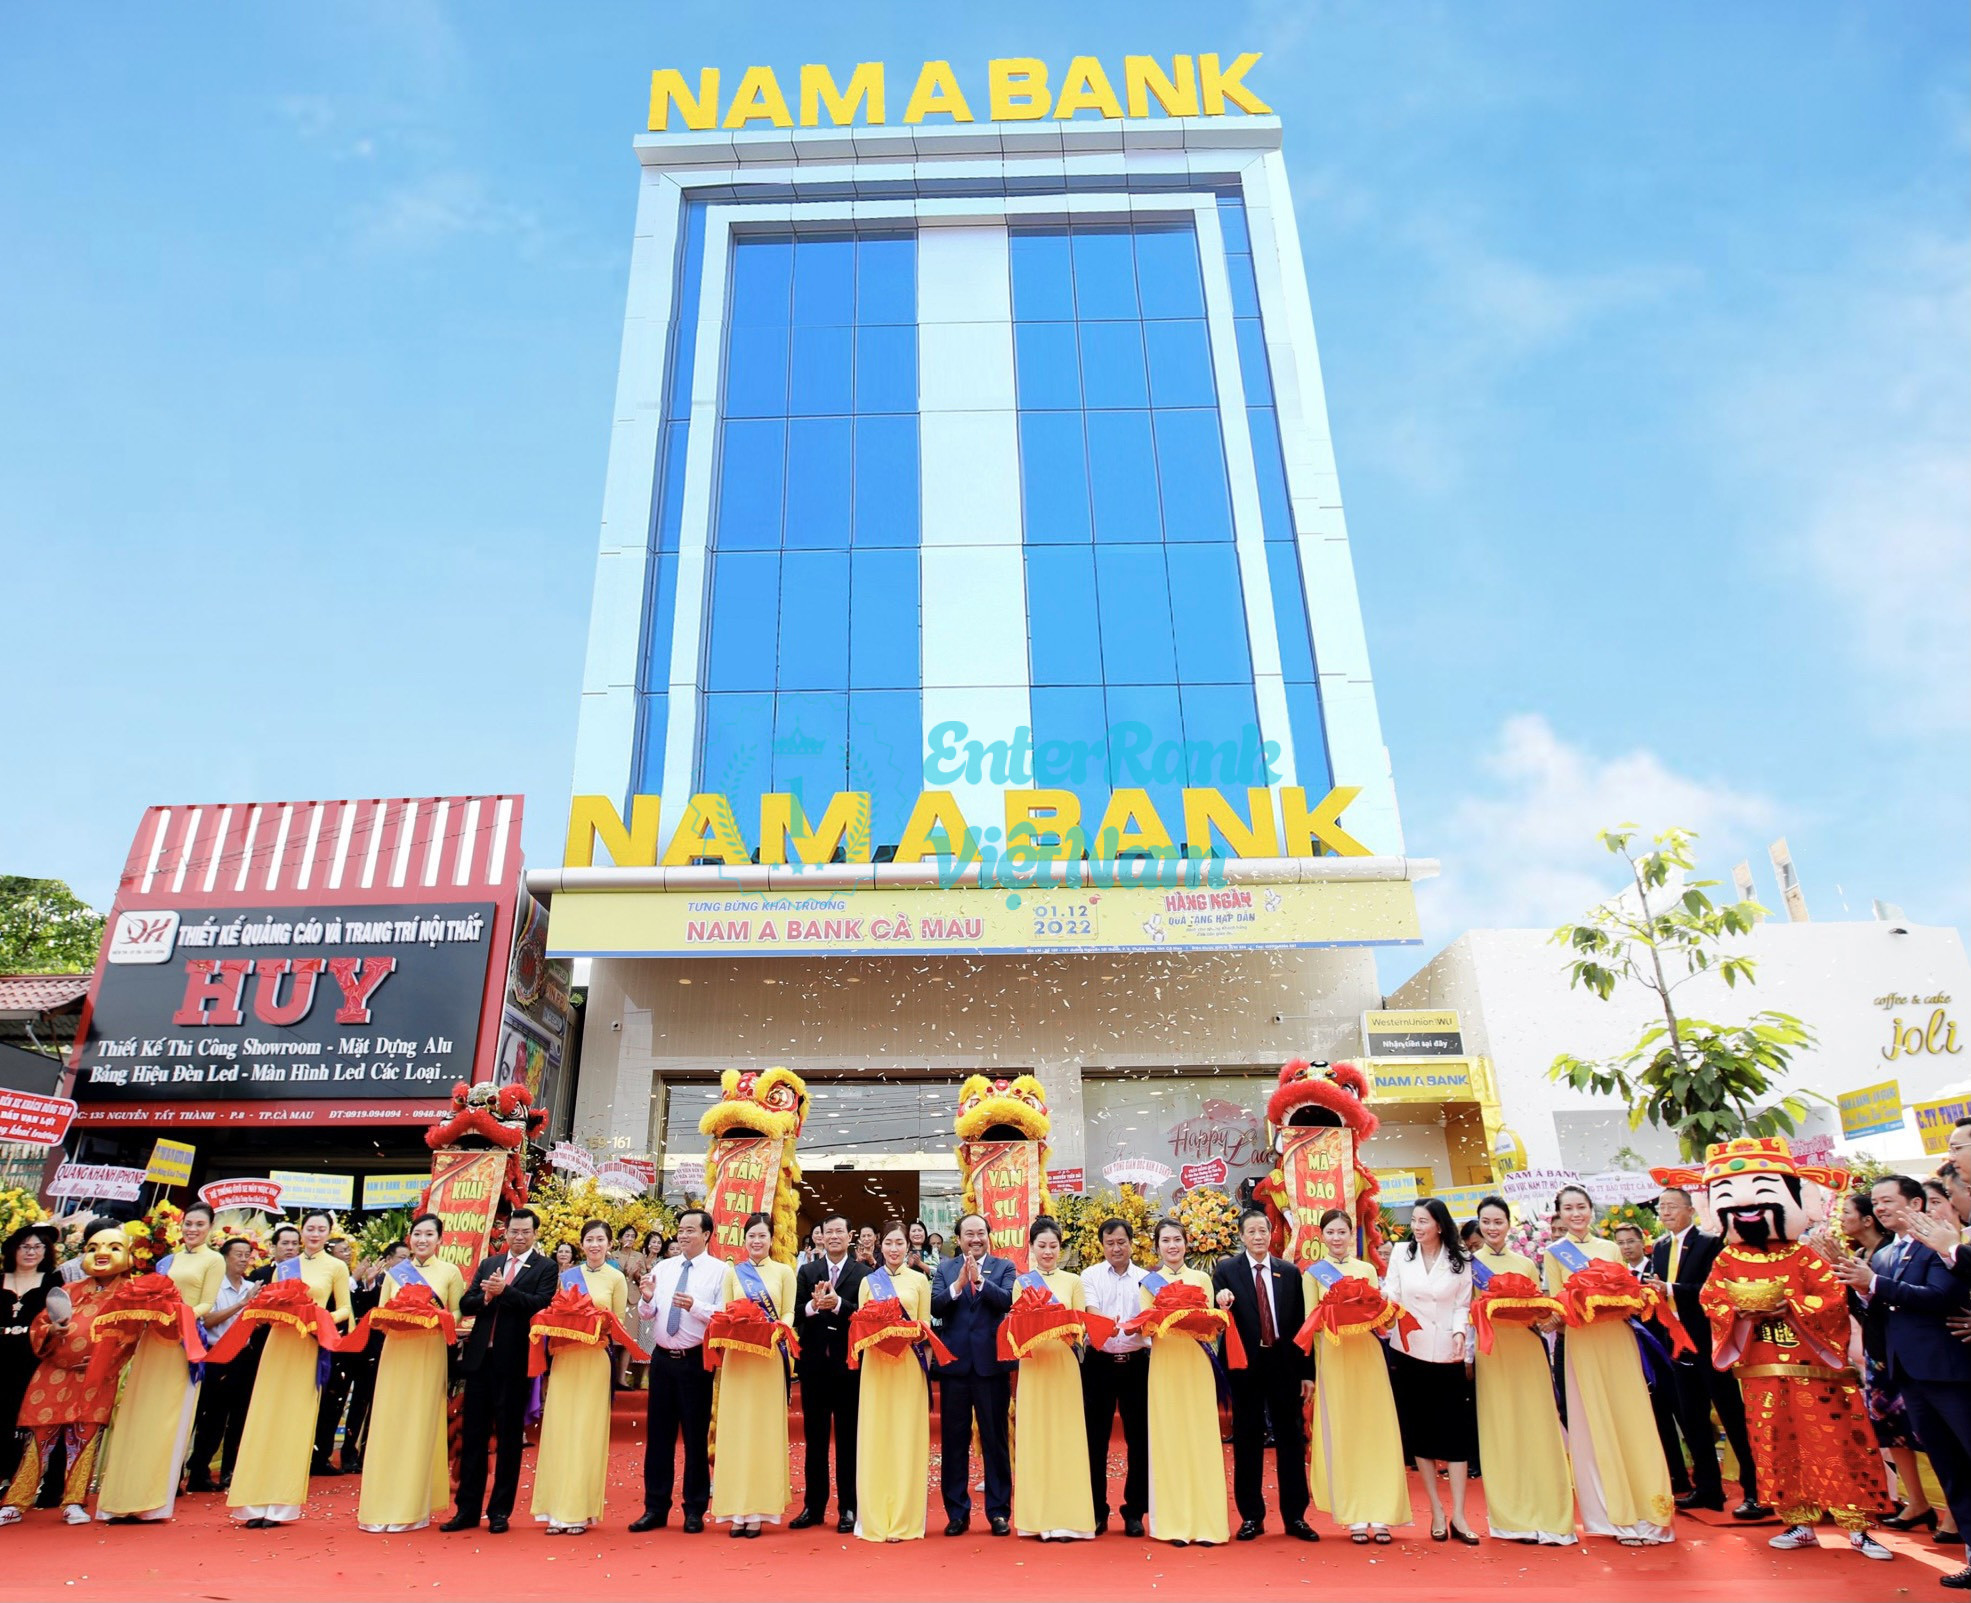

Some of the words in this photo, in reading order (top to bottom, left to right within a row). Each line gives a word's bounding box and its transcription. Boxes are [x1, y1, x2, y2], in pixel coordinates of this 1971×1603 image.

[647, 61, 885, 131] NAM
[903, 60, 975, 123] A
[987, 52, 1273, 121] BANK
[563, 792, 872, 868] NAM
[892, 790, 984, 864] A
[1004, 786, 1376, 862] BANK
[762, 901, 791, 912] KHAI
[1034, 905, 1089, 918] 01.12
[1165, 891, 1208, 912] HÀNG
[178, 915, 221, 947] THIẾT
[218, 914, 248, 946] KẾ
[241, 914, 293, 946] QUẢNG
[293, 916, 323, 945] CÁO
[325, 916, 342, 944] VÀ
[345, 920, 394, 944] TRANG
[394, 915, 422, 943] TRÍ
[419, 914, 446, 949] NỘI
[447, 912, 485, 942] THẤT
[686, 920, 750, 942] NAM
[758, 919, 779, 941] A
[787, 918, 863, 941] BANK
[870, 912, 913, 940] CÀ
[921, 917, 983, 940] MAU
[1033, 919, 1092, 935] 2022
[172, 956, 398, 1027] HUY
[1873, 991, 1909, 1011] coffee
[1911, 994, 1921, 1005] &
[1923, 990, 1953, 1005] cake
[1372, 1017, 1434, 1027] WesternUnion
[1437, 1017, 1453, 1026] WU
[1382, 1040, 1405, 1049] Nhận
[1881, 1008, 1964, 1061] joli
[98, 1036, 137, 1057] Thiết
[140, 1037, 168, 1057] Kế
[167, 1039, 194, 1057] Thi
[197, 1037, 238, 1060] Công
[242, 1037, 321, 1056] Showroom
[338, 1037, 371, 1059] Mặt
[374, 1037, 418, 1059] Dựng
[423, 1036, 453, 1054] Alu
[88, 1064, 128, 1087] Bảng
[131, 1065, 170, 1086] Hiệu
[172, 1064, 204, 1082] Đèn
[206, 1064, 240, 1082] Led
[250, 1064, 287, 1082] Màn
[289, 1063, 329, 1081] Hình
[333, 1062, 366, 1081] Led
[370, 1061, 400, 1080] Các
[1375, 1075, 1411, 1087] NAM
[1415, 1075, 1425, 1087] A
[1426, 1074, 1469, 1086] BANK
[89, 1111, 105, 1120] 135
[107, 1108, 149, 1120] NGUYỄN
[154, 1109, 176, 1120] TẤT
[180, 1109, 216, 1120] THÀNH
[229, 1111, 245, 1120] P.8
[289, 1111, 315, 1120] MAU
[1167, 1121, 1229, 1160] Happy
[727, 1154, 763, 1182] TẤN
[1506, 1171, 1532, 1180] NAM
[451, 1181, 484, 1200] KHAI
[986, 1169, 1023, 1191] VẠN
[1305, 1180, 1336, 1200] ĐÁO
[724, 1188, 754, 1215] TÀI
[994, 1197, 1018, 1221] SỰ
